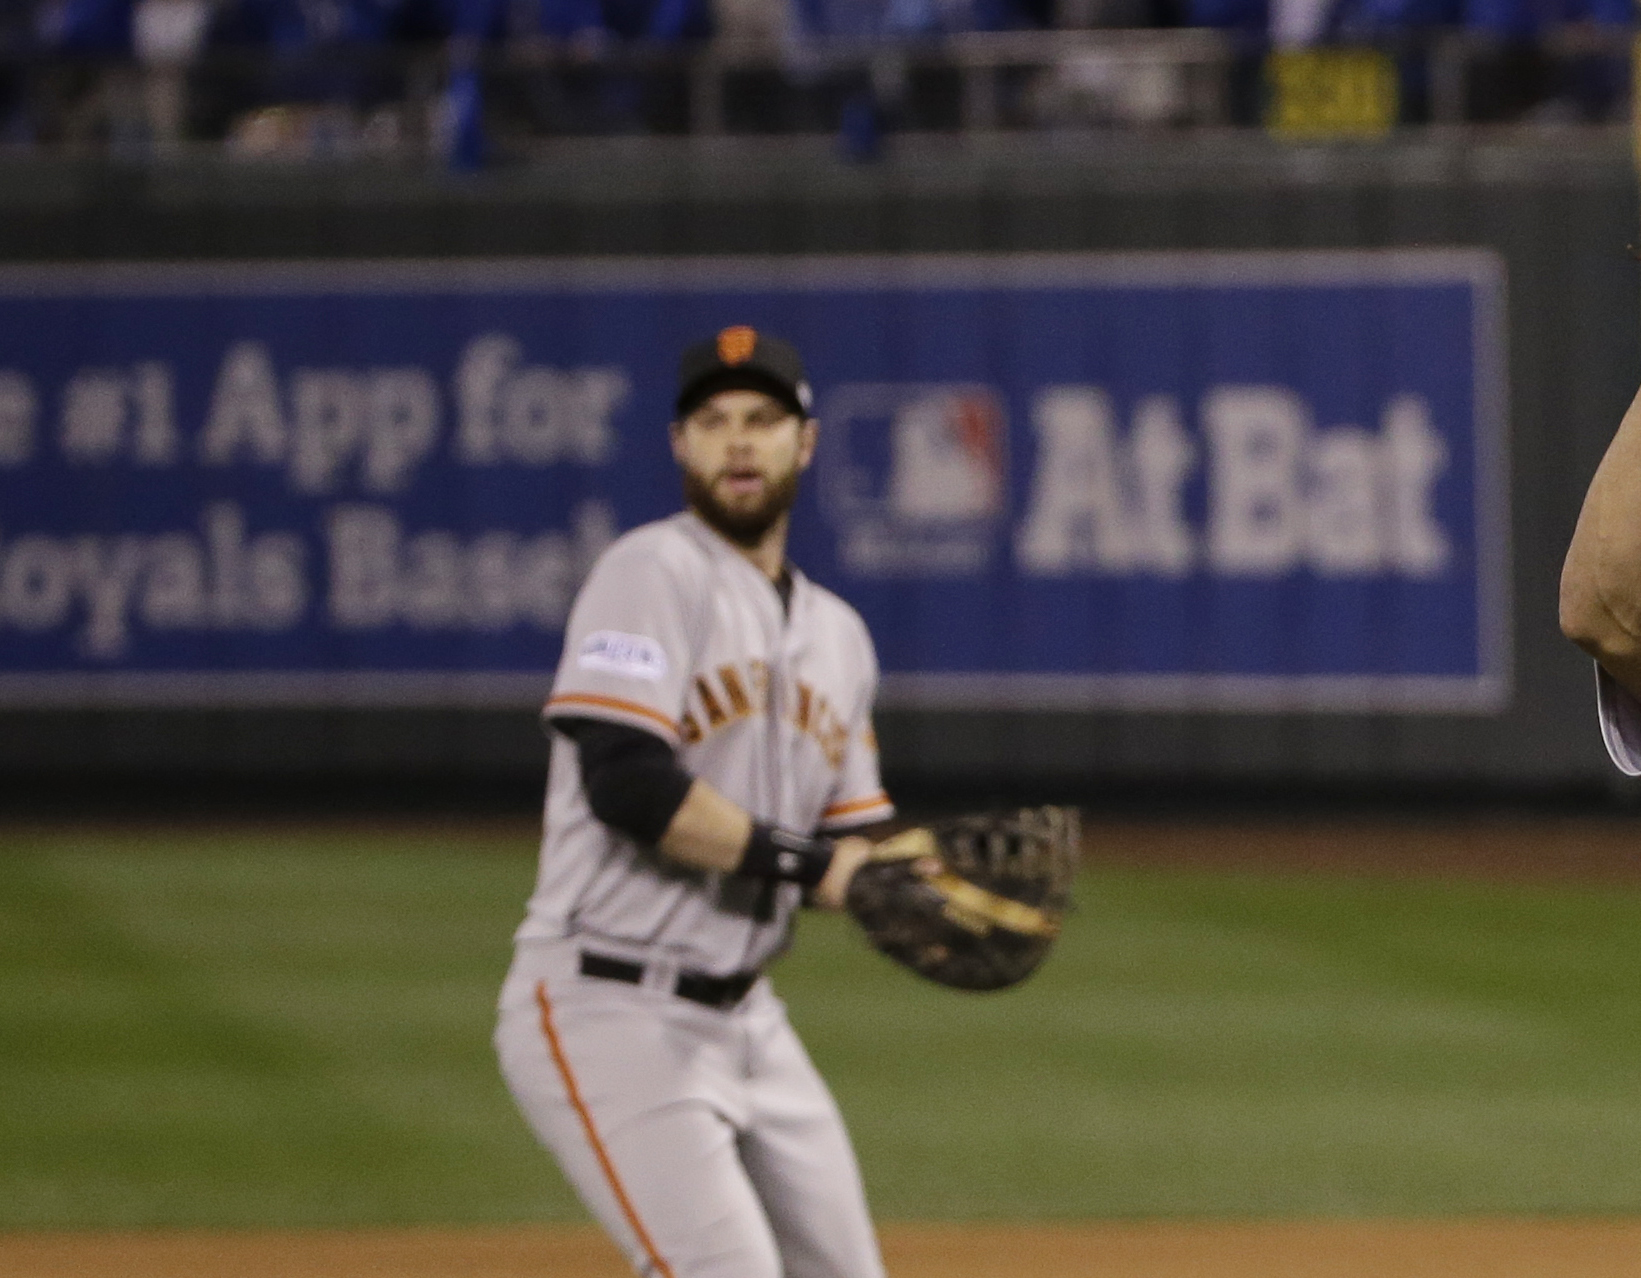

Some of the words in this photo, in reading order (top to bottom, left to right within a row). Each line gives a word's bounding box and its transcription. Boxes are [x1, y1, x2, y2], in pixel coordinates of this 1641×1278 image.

[200, 340, 440, 493] App
[456, 335, 628, 467] for
[1014, 383, 1196, 576] At
[1201, 383, 1448, 576] Bat
[0, 500, 303, 657] oyals
